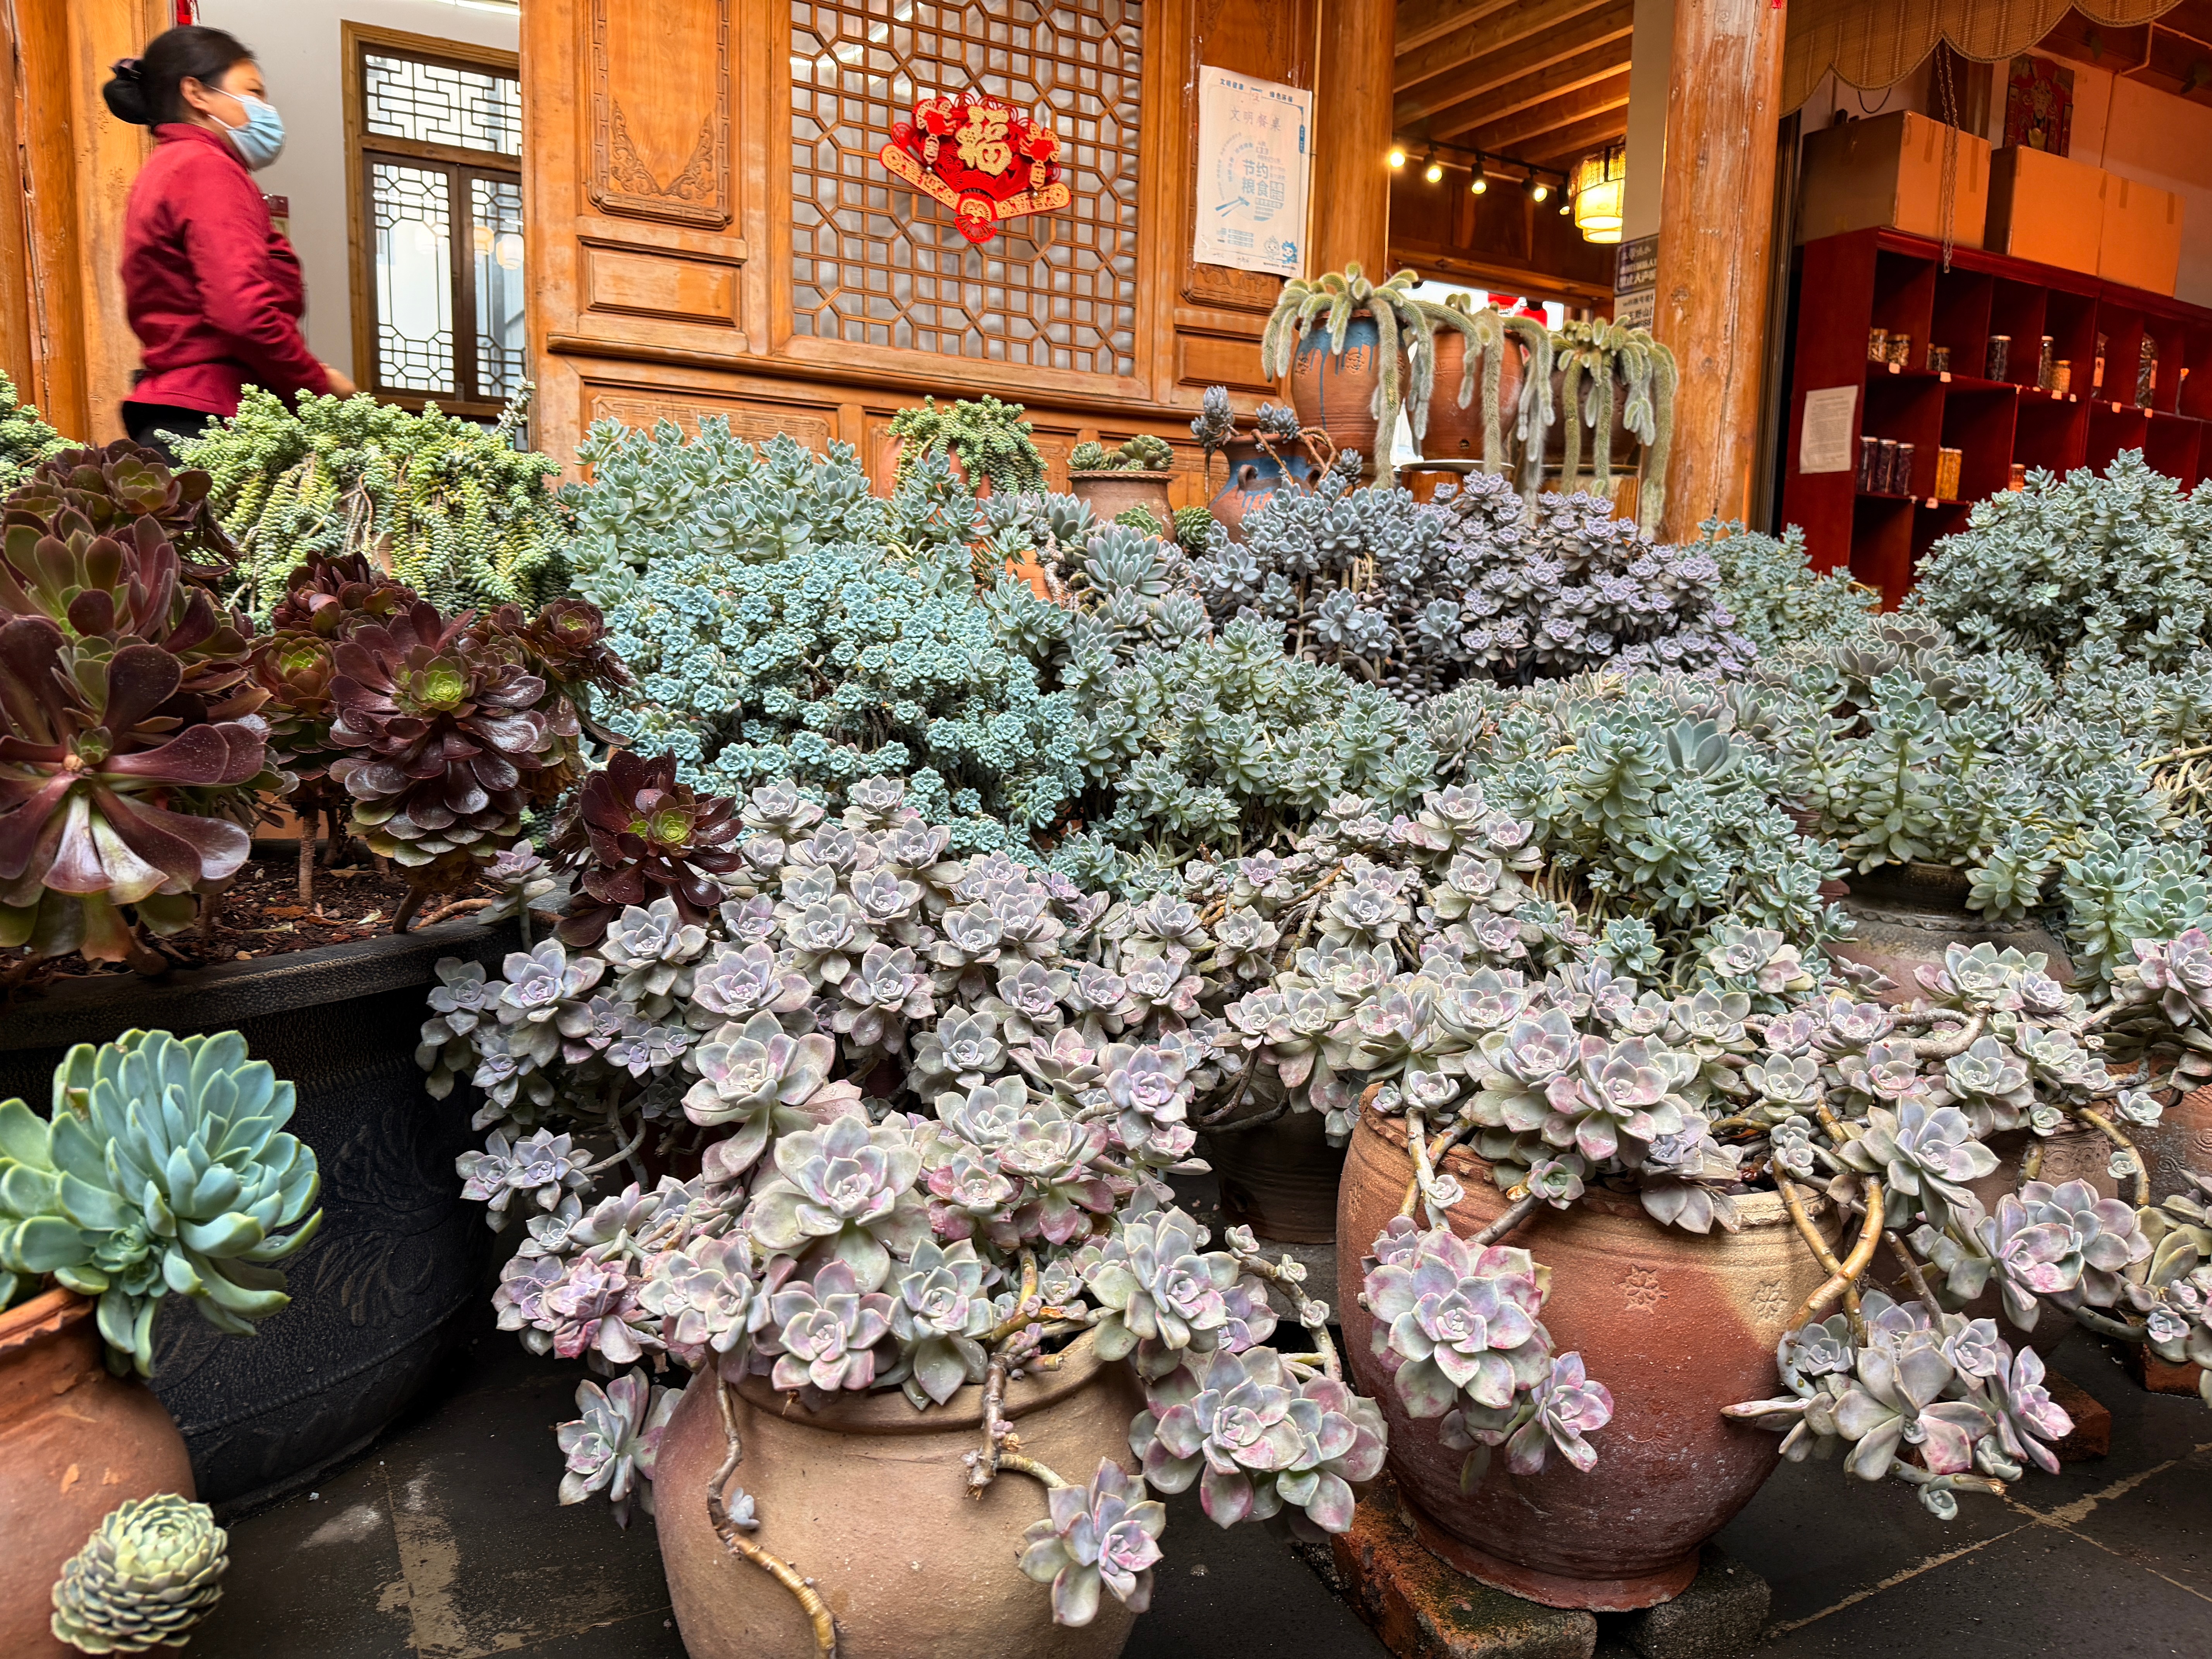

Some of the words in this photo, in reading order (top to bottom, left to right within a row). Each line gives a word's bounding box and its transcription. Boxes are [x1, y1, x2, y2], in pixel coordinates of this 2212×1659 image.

[1230, 106, 1281, 131] 文明餐桌
[955, 105, 1013, 176] 福
[1242, 159, 1269, 179] 节约
[1242, 177, 1269, 198] 粮食
